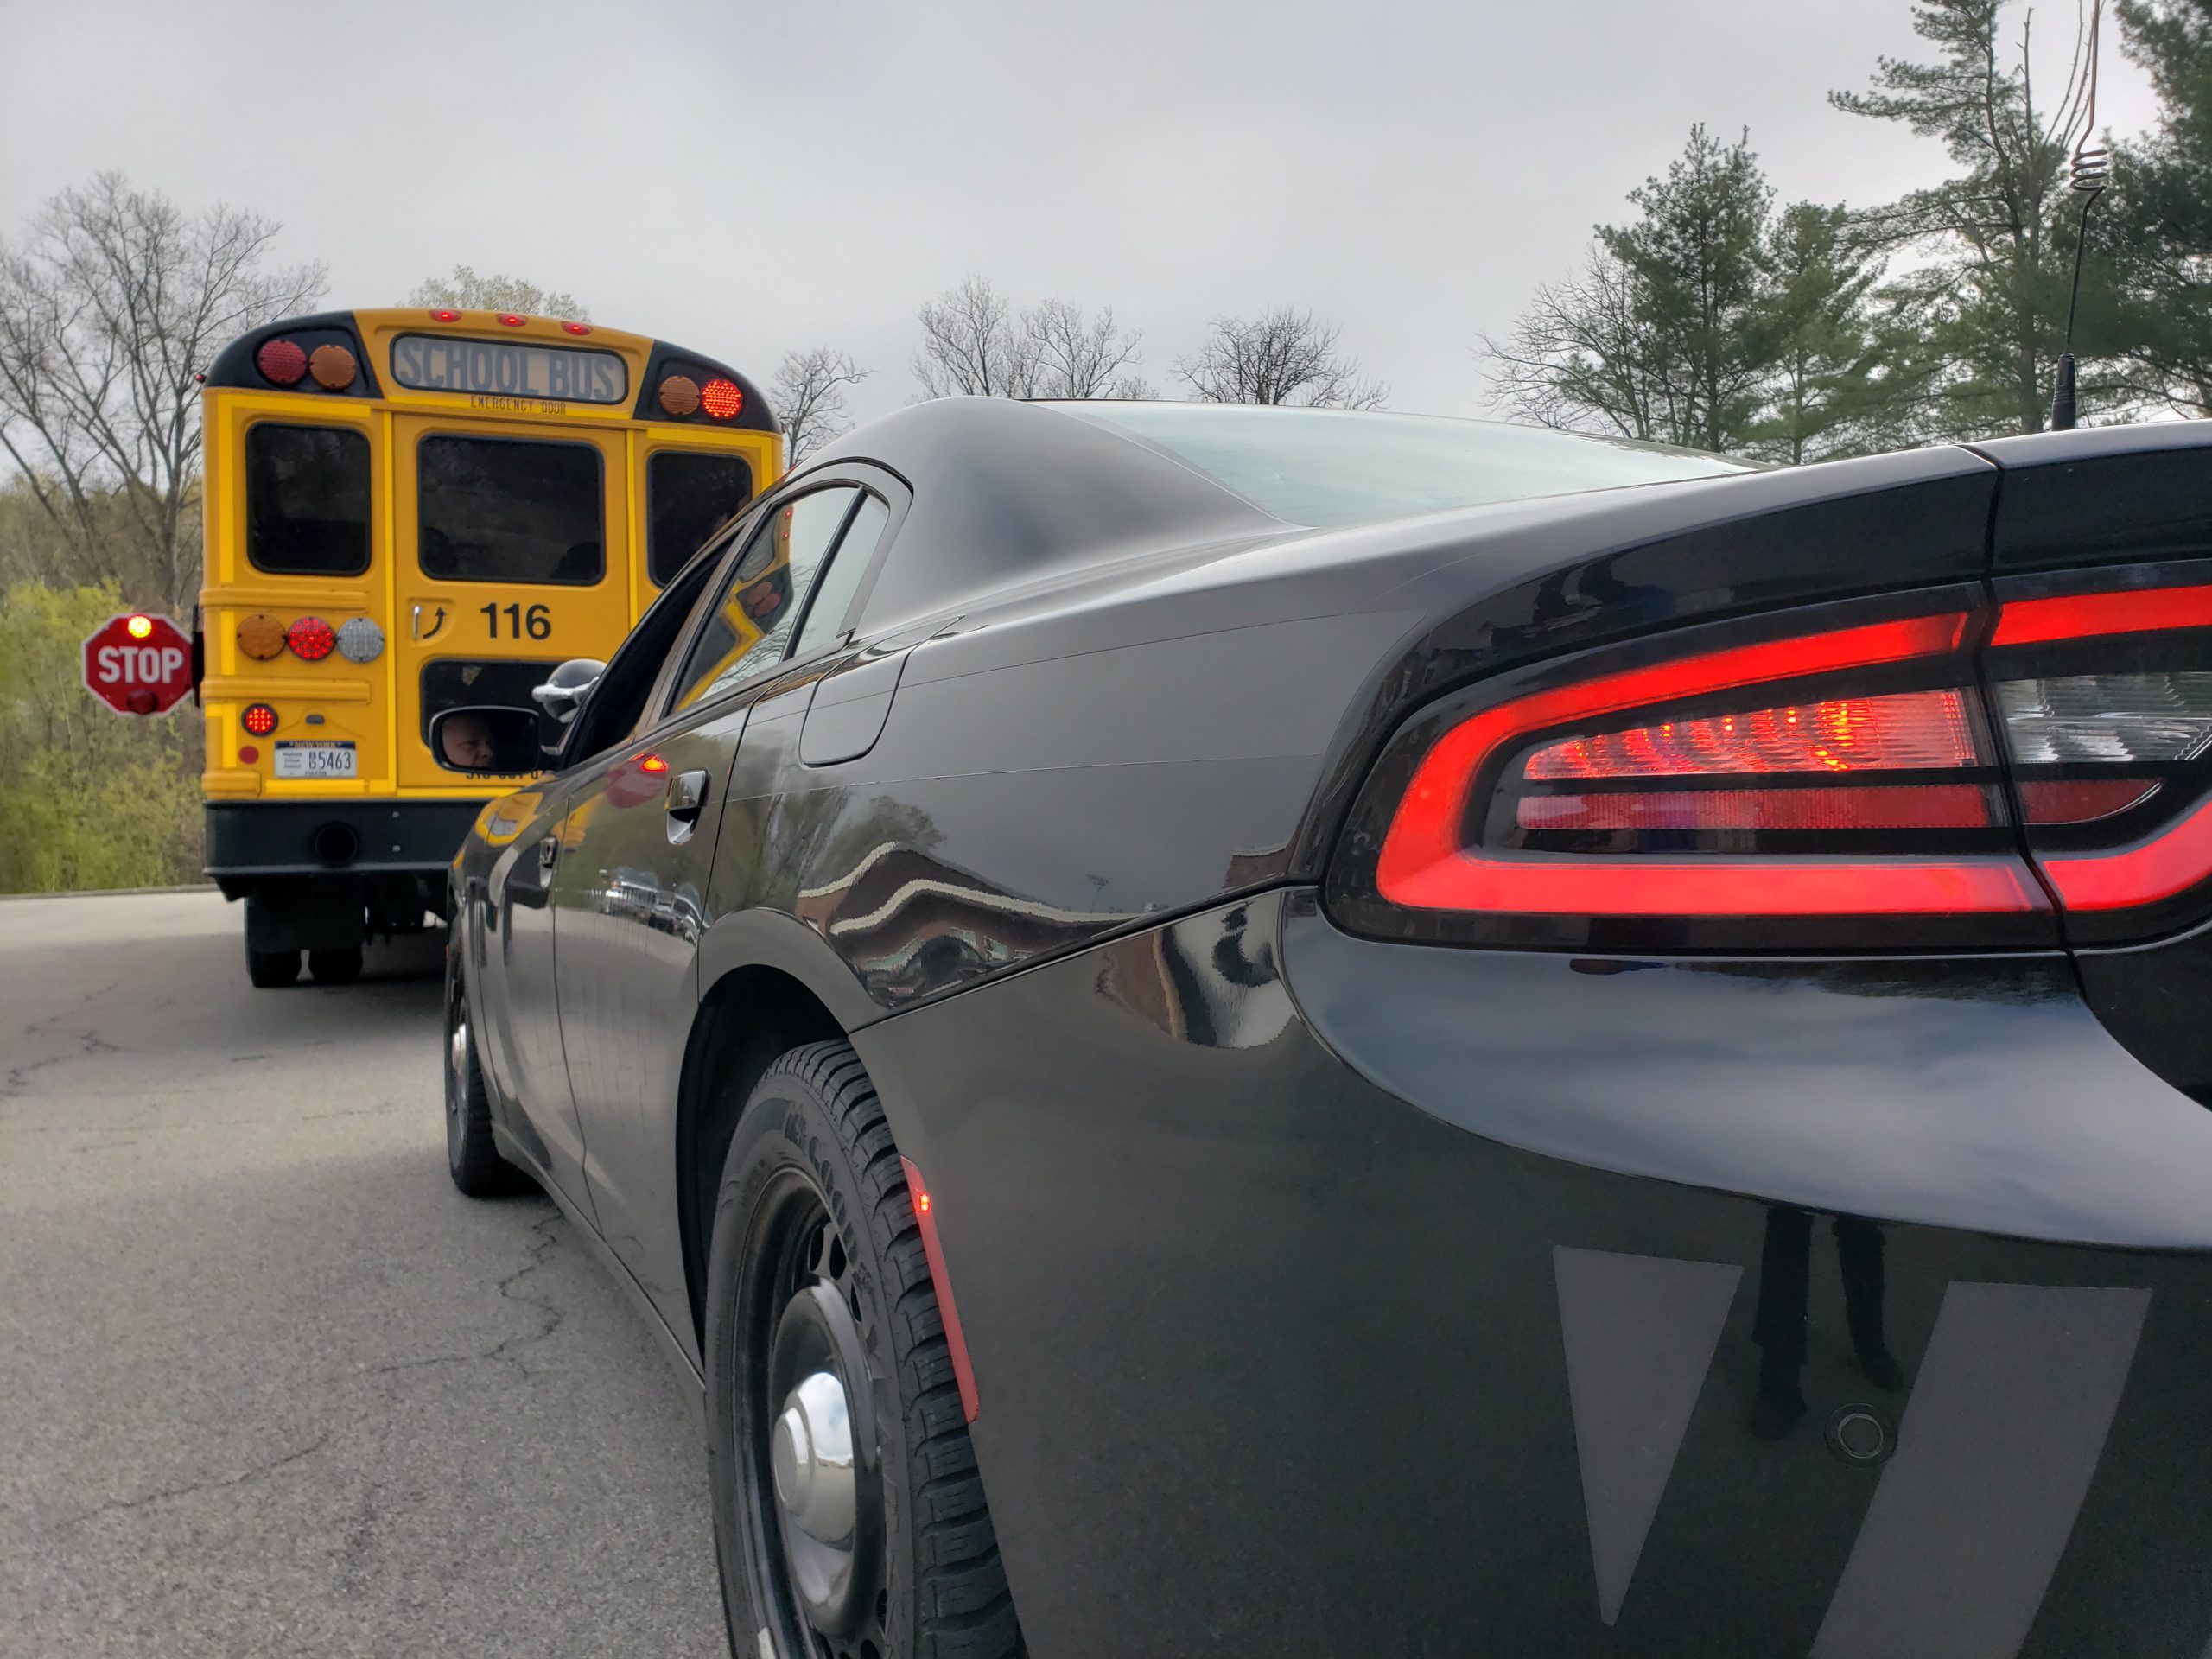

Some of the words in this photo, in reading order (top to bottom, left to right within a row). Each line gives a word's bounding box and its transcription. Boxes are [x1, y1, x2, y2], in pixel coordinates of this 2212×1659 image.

[399, 340, 539, 395] SCHOOL
[548, 351, 614, 402] BUS
[470, 395, 533, 413] EMERGENCY
[541, 400, 567, 415] DOOR
[480, 602, 551, 640] 116
[98, 646, 183, 684] STOP
